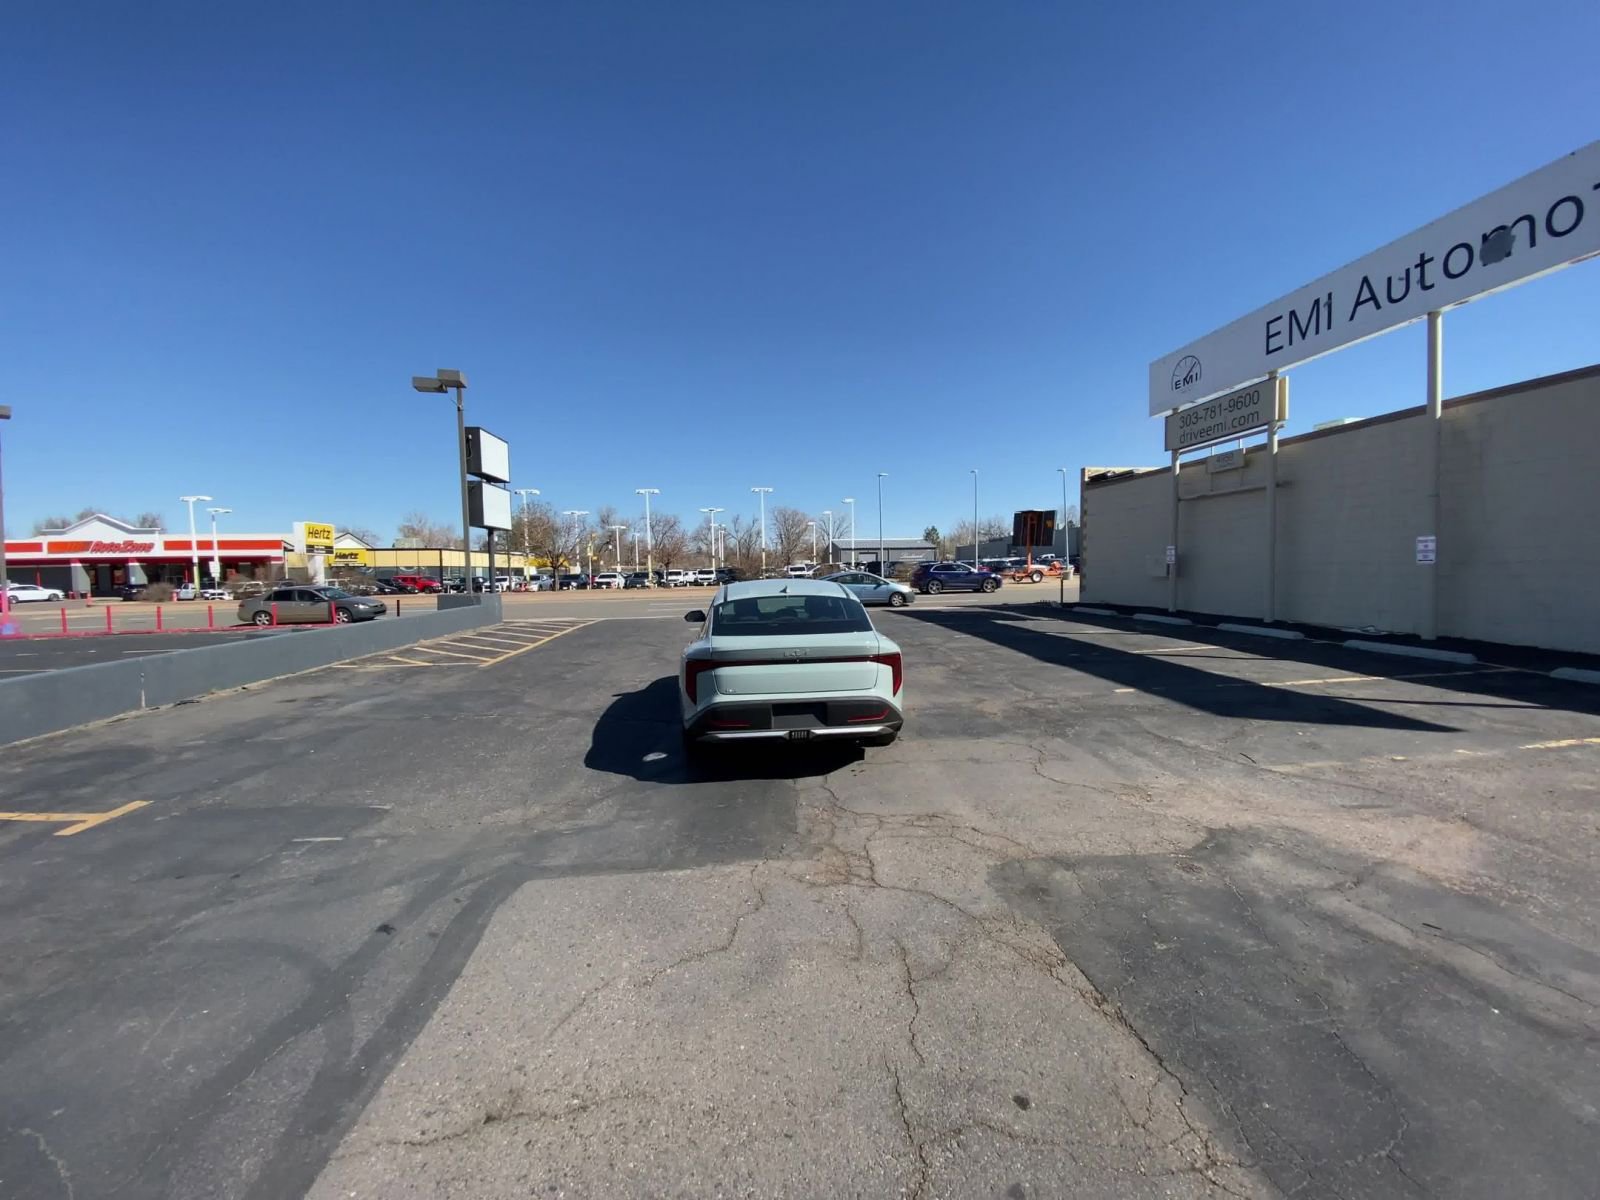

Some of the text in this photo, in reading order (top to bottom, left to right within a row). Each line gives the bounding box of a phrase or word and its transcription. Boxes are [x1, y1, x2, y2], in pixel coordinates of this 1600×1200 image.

[1349, 183, 1600, 322] Automo
[1174, 372, 1199, 390] EMI
[1180, 390, 1260, 429] 303-781-9600
[1180, 410, 1260, 443] driveemi.com
[308, 526, 331, 539] Hertz
